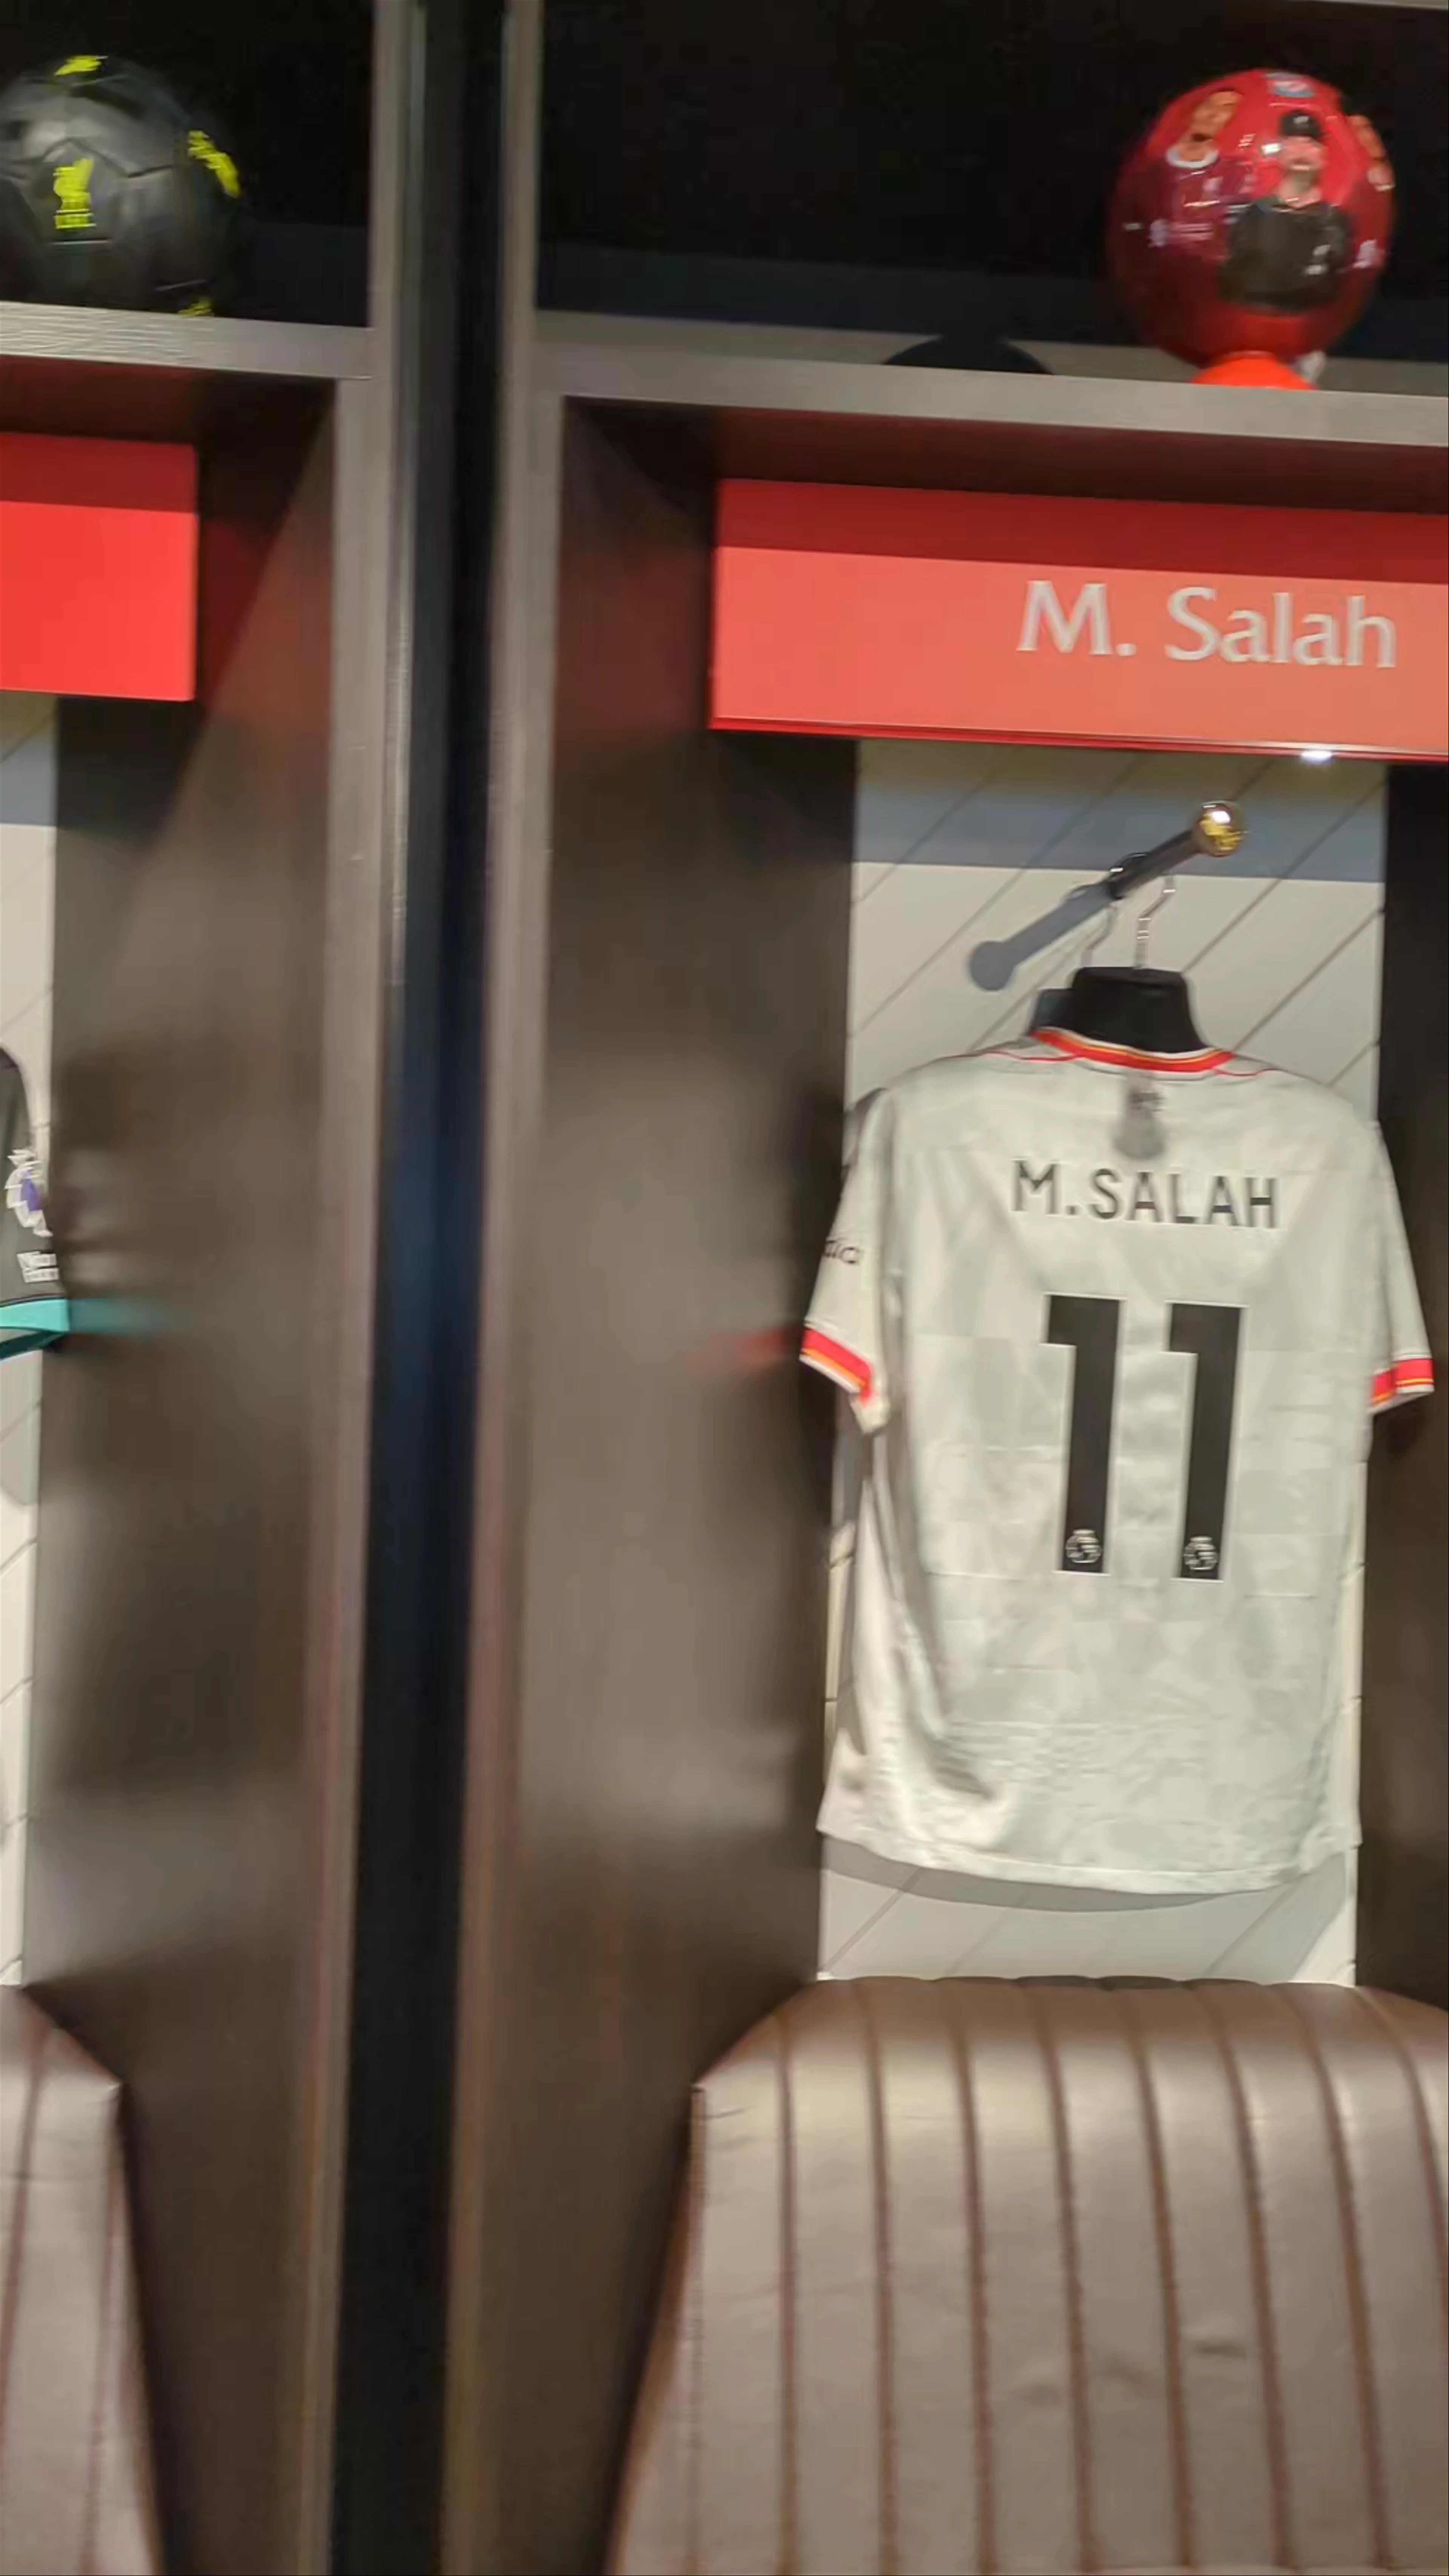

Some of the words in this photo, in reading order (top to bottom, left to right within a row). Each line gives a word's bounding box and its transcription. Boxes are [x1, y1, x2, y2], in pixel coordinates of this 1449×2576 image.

[1016, 580, 1136, 656] M.
[1165, 586, 1397, 668] Salah
[1010, 1158, 1278, 1229] M.SALAH
[1043, 1294, 1247, 1581] 11
